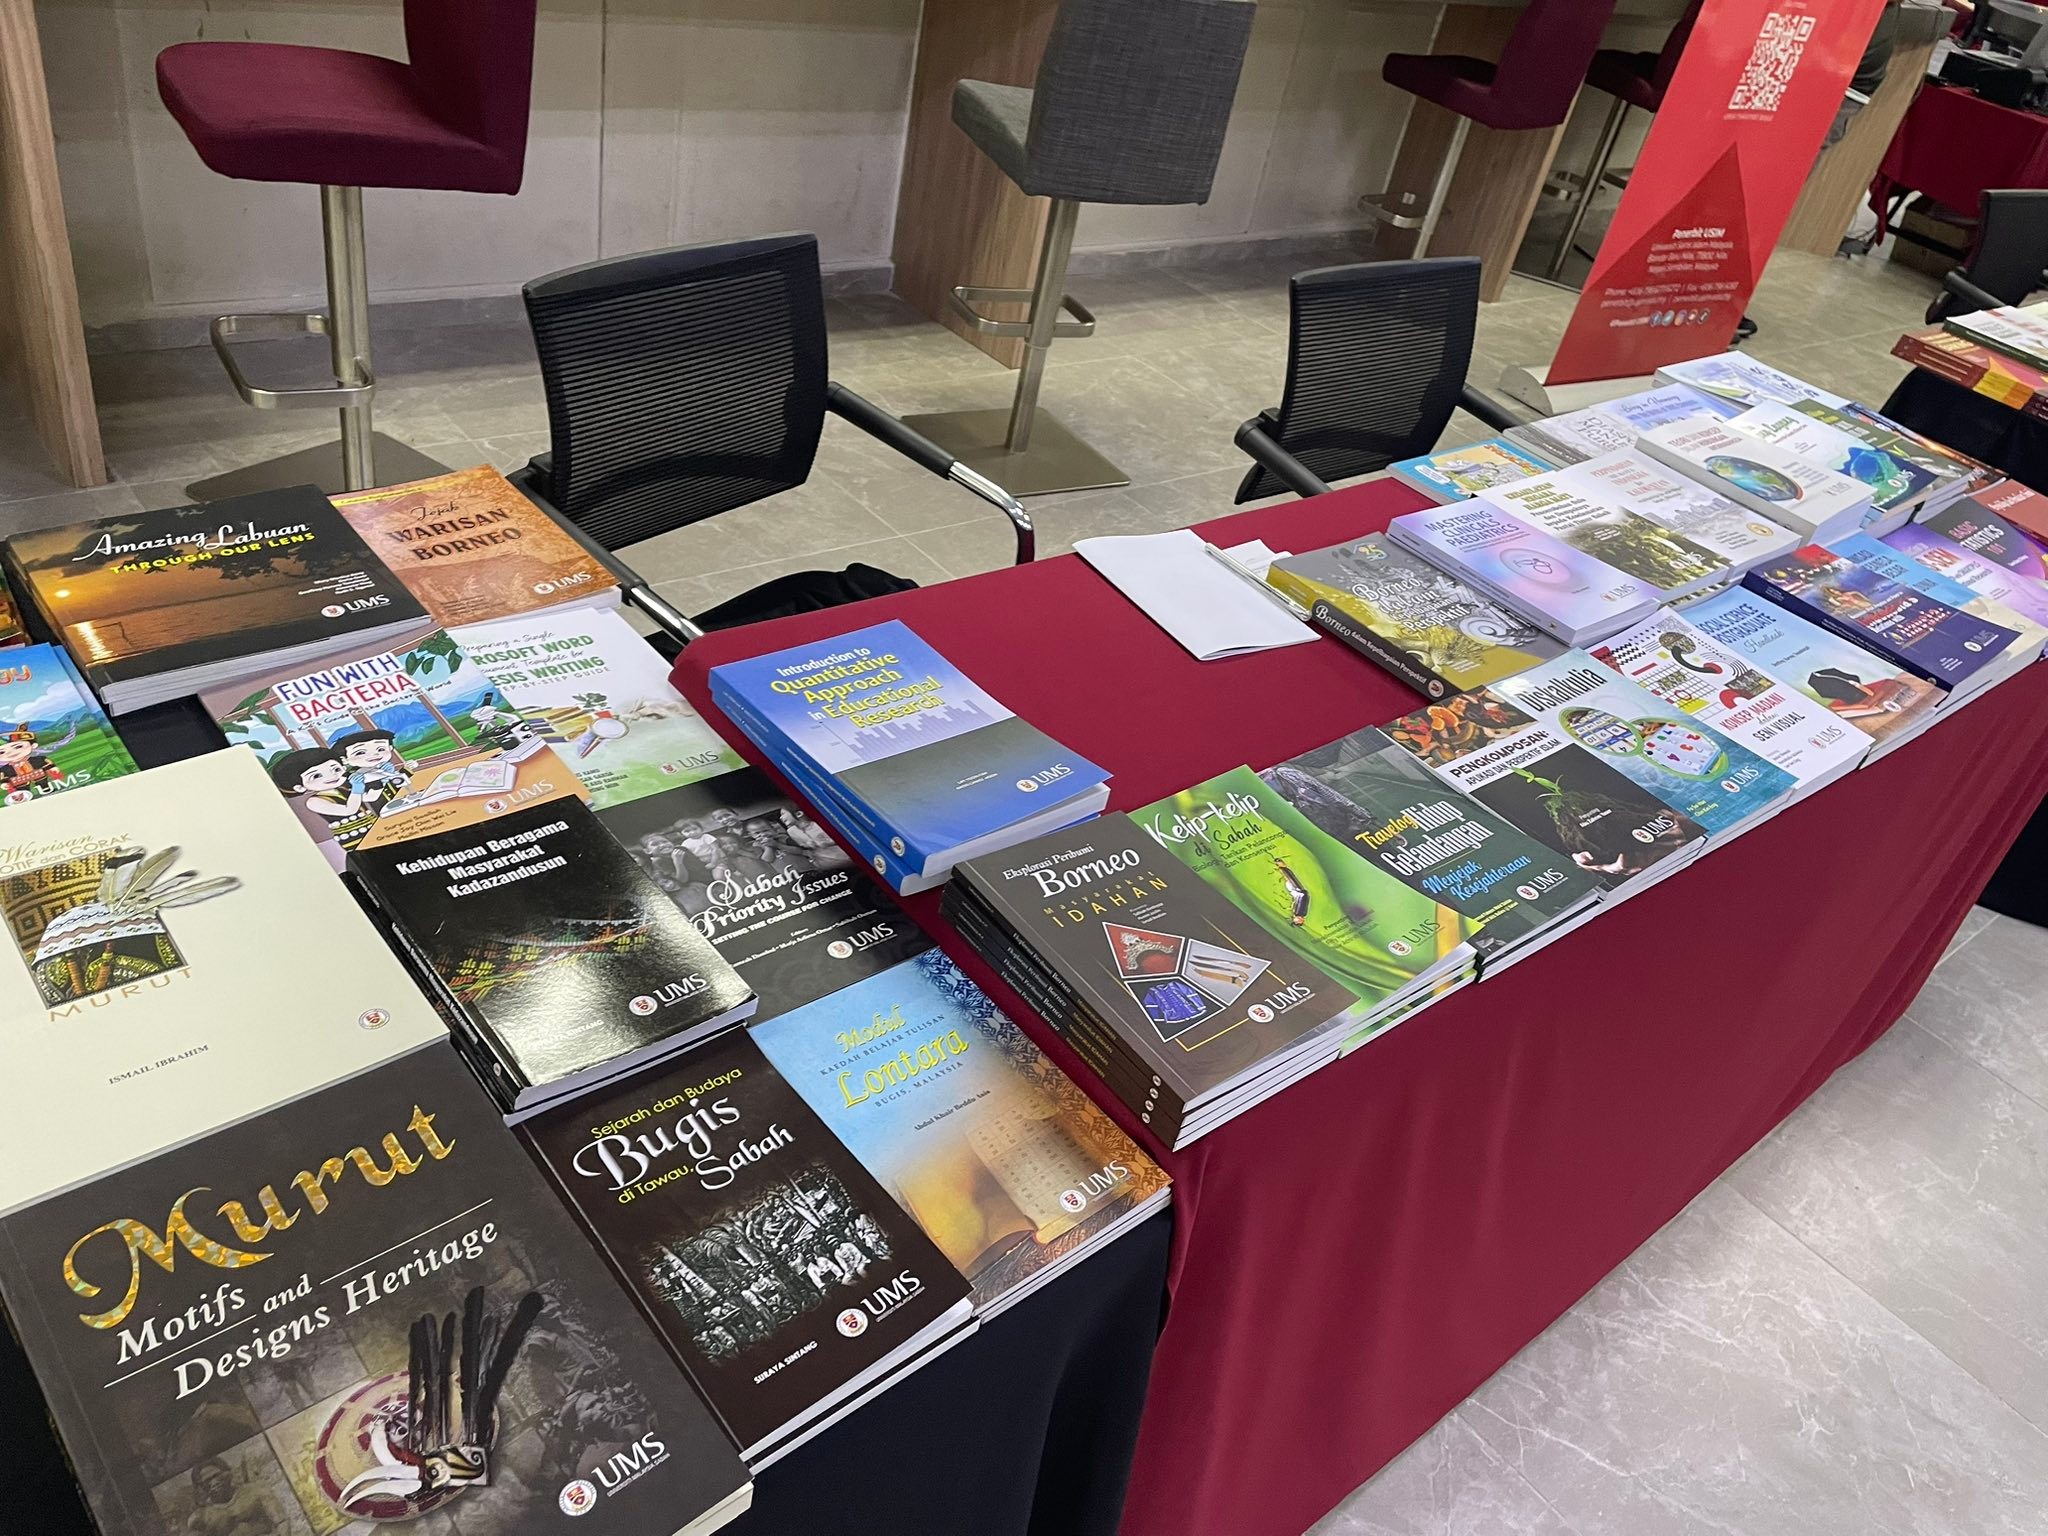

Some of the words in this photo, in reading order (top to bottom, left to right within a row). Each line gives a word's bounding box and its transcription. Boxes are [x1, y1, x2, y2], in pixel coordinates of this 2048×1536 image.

[386, 508, 510, 543] WARISAN
[1424, 510, 1493, 532] MASTERING
[1441, 519, 1501, 538] CLINICALS
[1446, 524, 1520, 547] PAEDIATRICS
[72, 531, 209, 562] Amazing
[202, 521, 310, 550] Labuan
[110, 551, 212, 574] THROUGH
[220, 542, 262, 557] OUR
[268, 533, 316, 548] LENS
[410, 527, 522, 560] BORNEO
[551, 570, 593, 589] UMS
[343, 594, 390, 611] UMS
[1315, 604, 1352, 637] Borneo
[1404, 604, 1470, 633] Perspektif
[1695, 613, 1725, 634] SOCIAL
[1723, 603, 1759, 624] SCIENCE
[1712, 612, 1776, 645] POSTGRADUATE
[470, 646, 540, 667] ROSOFT
[540, 635, 595, 653] WORD
[520, 653, 568, 668] Template
[571, 650, 585, 658] for
[776, 650, 853, 678] Introduction
[853, 646, 872, 658] to
[276, 673, 336, 702] FUN
[335, 654, 401, 685] WITH
[487, 671, 529, 687] ESIS
[529, 656, 606, 680] WRITING
[502, 675, 569, 692] EP-BY-STEP
[573, 667, 611, 679] GUIDE
[770, 651, 900, 696] Quantitative
[803, 668, 904, 706] Approach
[1516, 667, 1609, 713] Diskalkulia
[289, 673, 418, 721] BACTERIA
[808, 710, 824, 721] in
[821, 676, 944, 719] Educational
[851, 692, 945, 730] Research
[1719, 707, 1751, 731] KONSEP
[1750, 692, 1786, 714] MADANI
[1752, 723, 1777, 742] SENI
[1774, 711, 1806, 732] VISUAL
[1816, 725, 1842, 744] UMS
[676, 750, 721, 771] UMS
[1450, 730, 1550, 778] PENGKOMPOSAN:
[1465, 770, 1496, 786] APLIKASI
[1492, 762, 1509, 774] DAN
[1506, 747, 1541, 768] PERSPEKTIF
[1539, 738, 1562, 752] ISLAM
[34, 769, 91, 795] UMS
[507, 779, 556, 804] UMS
[1033, 763, 1072, 786] UMS
[1733, 766, 1760, 786] UMS
[1144, 792, 1264, 848] Kelip-kelip
[1193, 841, 1211, 857] di
[1213, 819, 1262, 850] Sabah
[1355, 811, 1420, 850] Travelog
[1407, 801, 1464, 833] Hidup
[1642, 816, 1674, 834] UMS
[0, 833, 94, 865] Warisan
[0, 858, 35, 876] OTIF
[39, 851, 69, 865] dan
[68, 833, 133, 857] CORAK
[395, 841, 488, 879] Kehidupan
[484, 817, 570, 856] Beragama
[446, 845, 546, 882] Masyarakat
[1002, 858, 1052, 880] Eksplorasi
[1053, 843, 1095, 866] Peribumi
[1220, 845, 1247, 860] Tarikan
[1224, 859, 1239, 869] dan
[1239, 844, 1277, 861] Konservasi
[1380, 819, 1495, 877] Gelandangan
[446, 854, 568, 900] Kadazandusun
[1030, 847, 1141, 899] Borneo
[1422, 860, 1483, 896] Menjejak
[1450, 854, 1532, 901] Kesejahteraan
[1534, 867, 1565, 891] UMS
[690, 893, 786, 938] Priority
[790, 871, 849, 905] Issues
[1043, 871, 1155, 915] Masyarakat
[1053, 877, 1168, 928] IDAHAN
[712, 926, 748, 945] SETTING
[749, 919, 766, 932] THE
[767, 906, 801, 924] COURSE
[801, 900, 820, 911] FOR
[819, 889, 853, 905] CHANGE
[848, 922, 894, 948] UMS
[1400, 919, 1441, 945] UMS
[49, 967, 193, 1022] MURUT
[653, 972, 707, 1003] UMS
[1047, 985, 1067, 1007] Borneo
[1052, 972, 1072, 993] Borneo
[1265, 982, 1311, 1010] UMS
[1040, 1010, 1060, 1031] Borneo
[1043, 997, 1063, 1019] Borneo
[820, 1053, 861, 1076] KAEDAH
[862, 1035, 904, 1057] BELAJAR
[904, 1014, 945, 1037] TULISAN
[836, 1004, 907, 1054] Modul
[108, 1064, 155, 1085] ISMAIL
[154, 1043, 210, 1070] IBRAHIM
[838, 1029, 970, 1108] Lontara
[591, 1108, 652, 1139] Sejarah
[653, 1093, 684, 1113] dan
[684, 1067, 743, 1100] Budaya
[874, 1088, 912, 1108] BUGIS,
[913, 1061, 964, 1088] MALAYSIA
[572, 1096, 741, 1191] Bugis
[618, 1188, 635, 1204] di
[634, 1165, 694, 1194] Tawau,
[695, 1123, 796, 1190] Sabah
[1079, 1159, 1130, 1196] UMS
[62, 1104, 456, 1330] Murut
[172, 1304, 332, 1400] Designs
[341, 1221, 498, 1315] Heritage
[860, 1269, 921, 1316] UMS
[116, 1282, 246, 1365] Motifs
[263, 1274, 313, 1314] and
[753, 1360, 785, 1384] SURAYA
[784, 1341, 818, 1366] SINTANG
[591, 1431, 665, 1488] UMS
